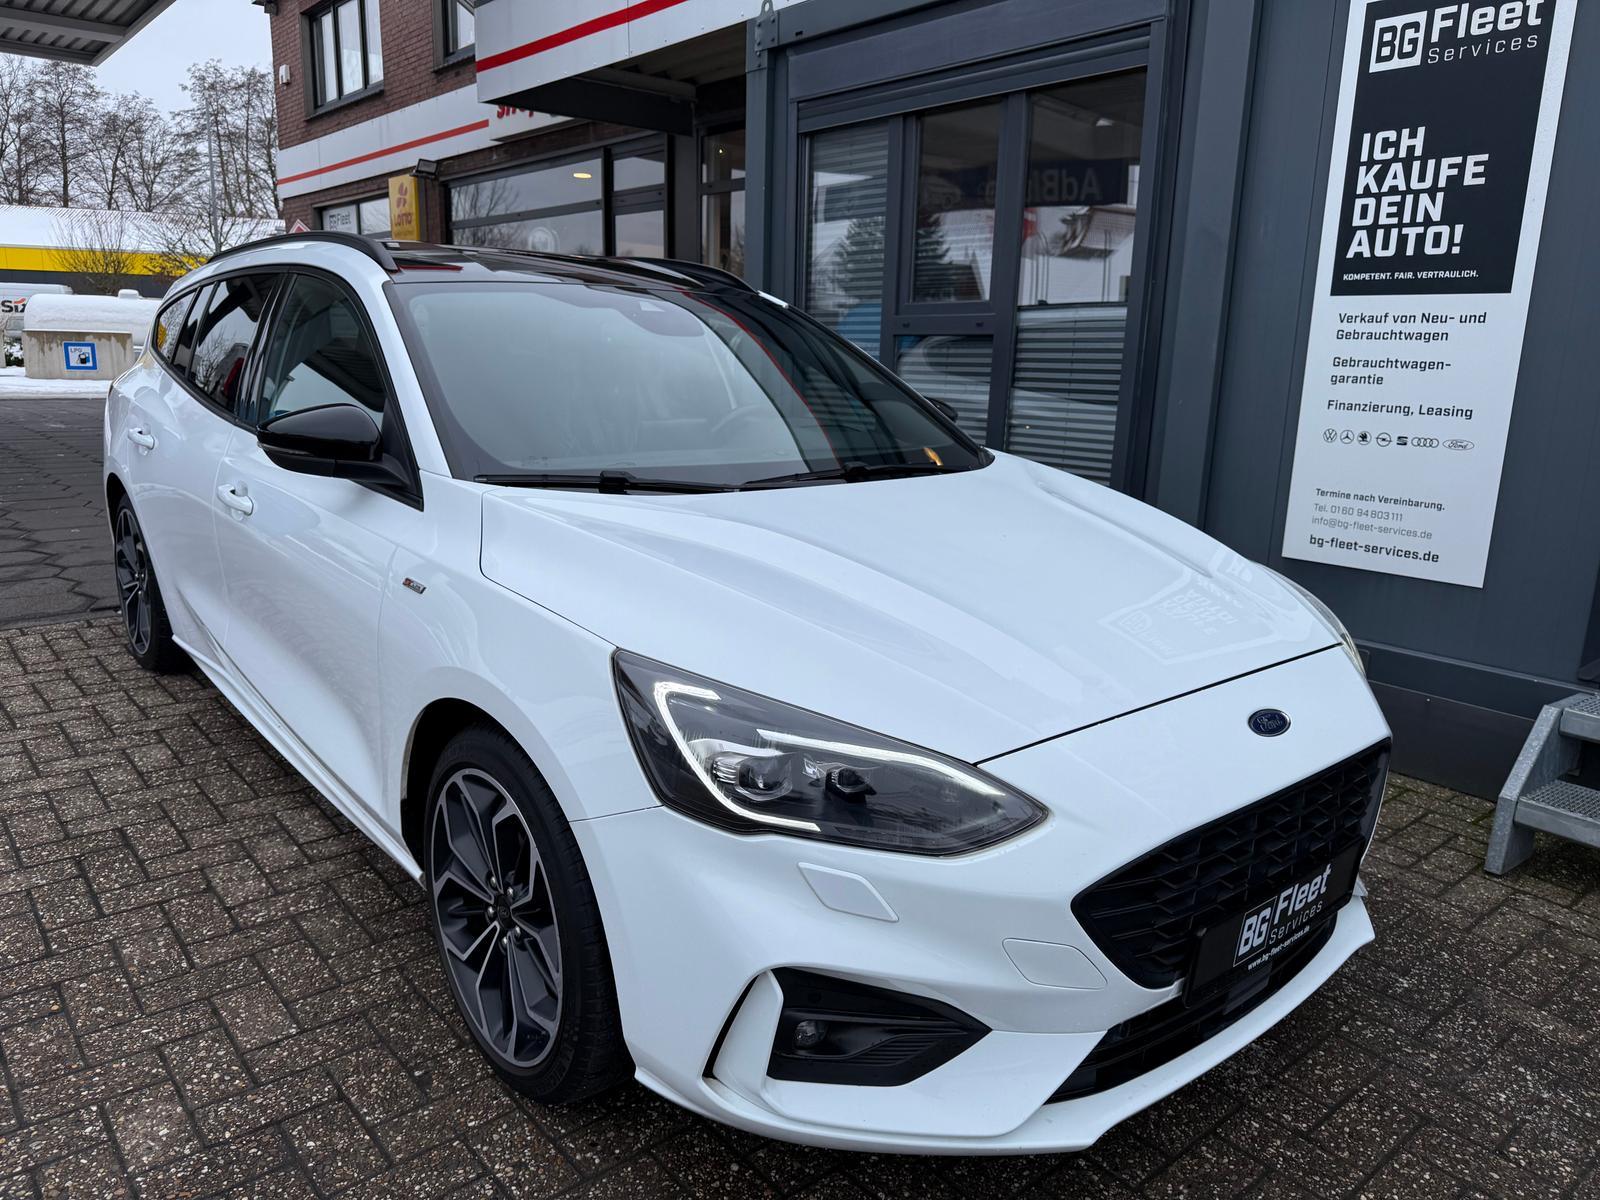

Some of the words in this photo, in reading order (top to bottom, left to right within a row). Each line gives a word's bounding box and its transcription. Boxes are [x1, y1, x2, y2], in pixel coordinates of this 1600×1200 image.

[1373, 18, 1423, 66] BG
[1430, 0, 1545, 43] Fleet
[1427, 35, 1538, 64] Services
[1360, 126, 1426, 162] ICH
[1356, 153, 1489, 194] KAUFE
[1351, 191, 1444, 227] DEIN
[1346, 224, 1464, 259] AUTO!
[1343, 272, 1392, 281] KOMPETENT.
[1394, 271, 1415, 279] FAIR.
[1417, 270, 1479, 279] VERTRAULICH.
[1338, 312, 1389, 324] Verkauf
[1392, 314, 1416, 324] von
[1420, 312, 1455, 324] Neu-
[1459, 312, 1487, 324] und
[1336, 329, 1449, 343] Gebrauchtwagen
[1332, 356, 1452, 372] Gebrauchtwagen-
[1330, 374, 1384, 386] garantie
[1327, 399, 1414, 417] Finanzierung,
[1418, 404, 1473, 420] Leasing
[1314, 503, 1328, 513] Tel.
[1315, 488, 1351, 500] Termine
[1353, 493, 1376, 503] nach
[1377, 495, 1445, 511] Vereinbarung.
[1311, 515, 1433, 540] info@bg-fleet-services.de
[1309, 534, 1440, 563] bg-fleet-services.de
[1237, 905, 1273, 959] BG
[1273, 863, 1332, 925] Fleet
[1269, 900, 1323, 945] Services
